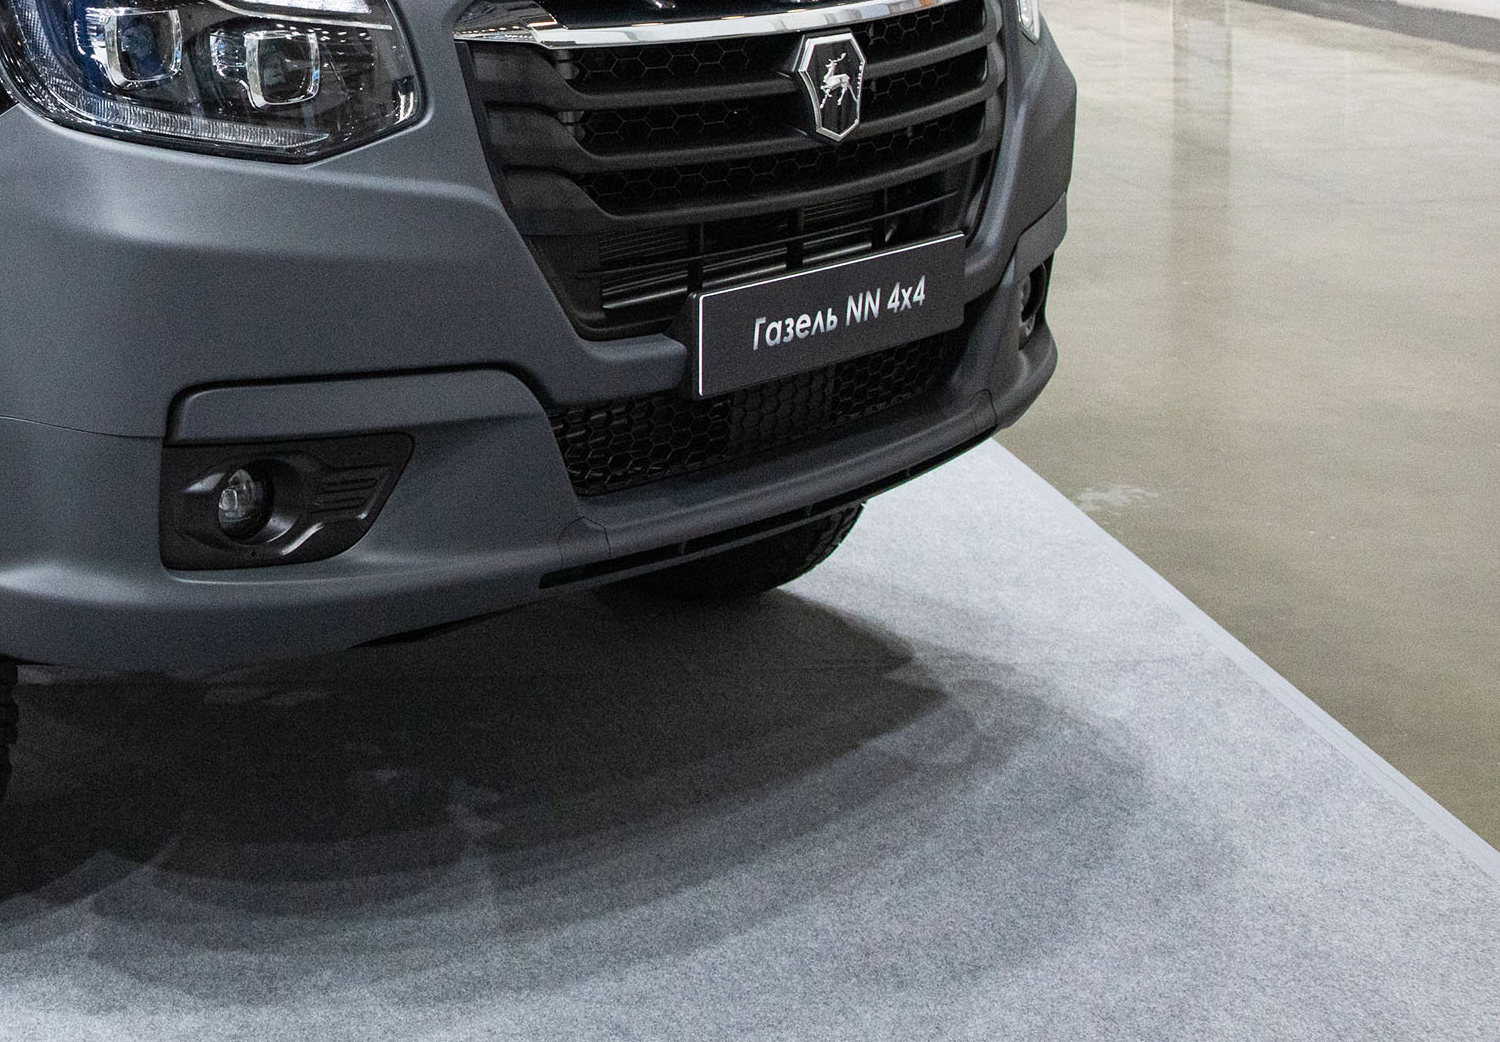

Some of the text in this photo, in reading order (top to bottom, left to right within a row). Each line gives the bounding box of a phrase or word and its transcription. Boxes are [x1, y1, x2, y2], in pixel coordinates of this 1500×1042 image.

[753, 275, 926, 350] Газель NN 4x4
